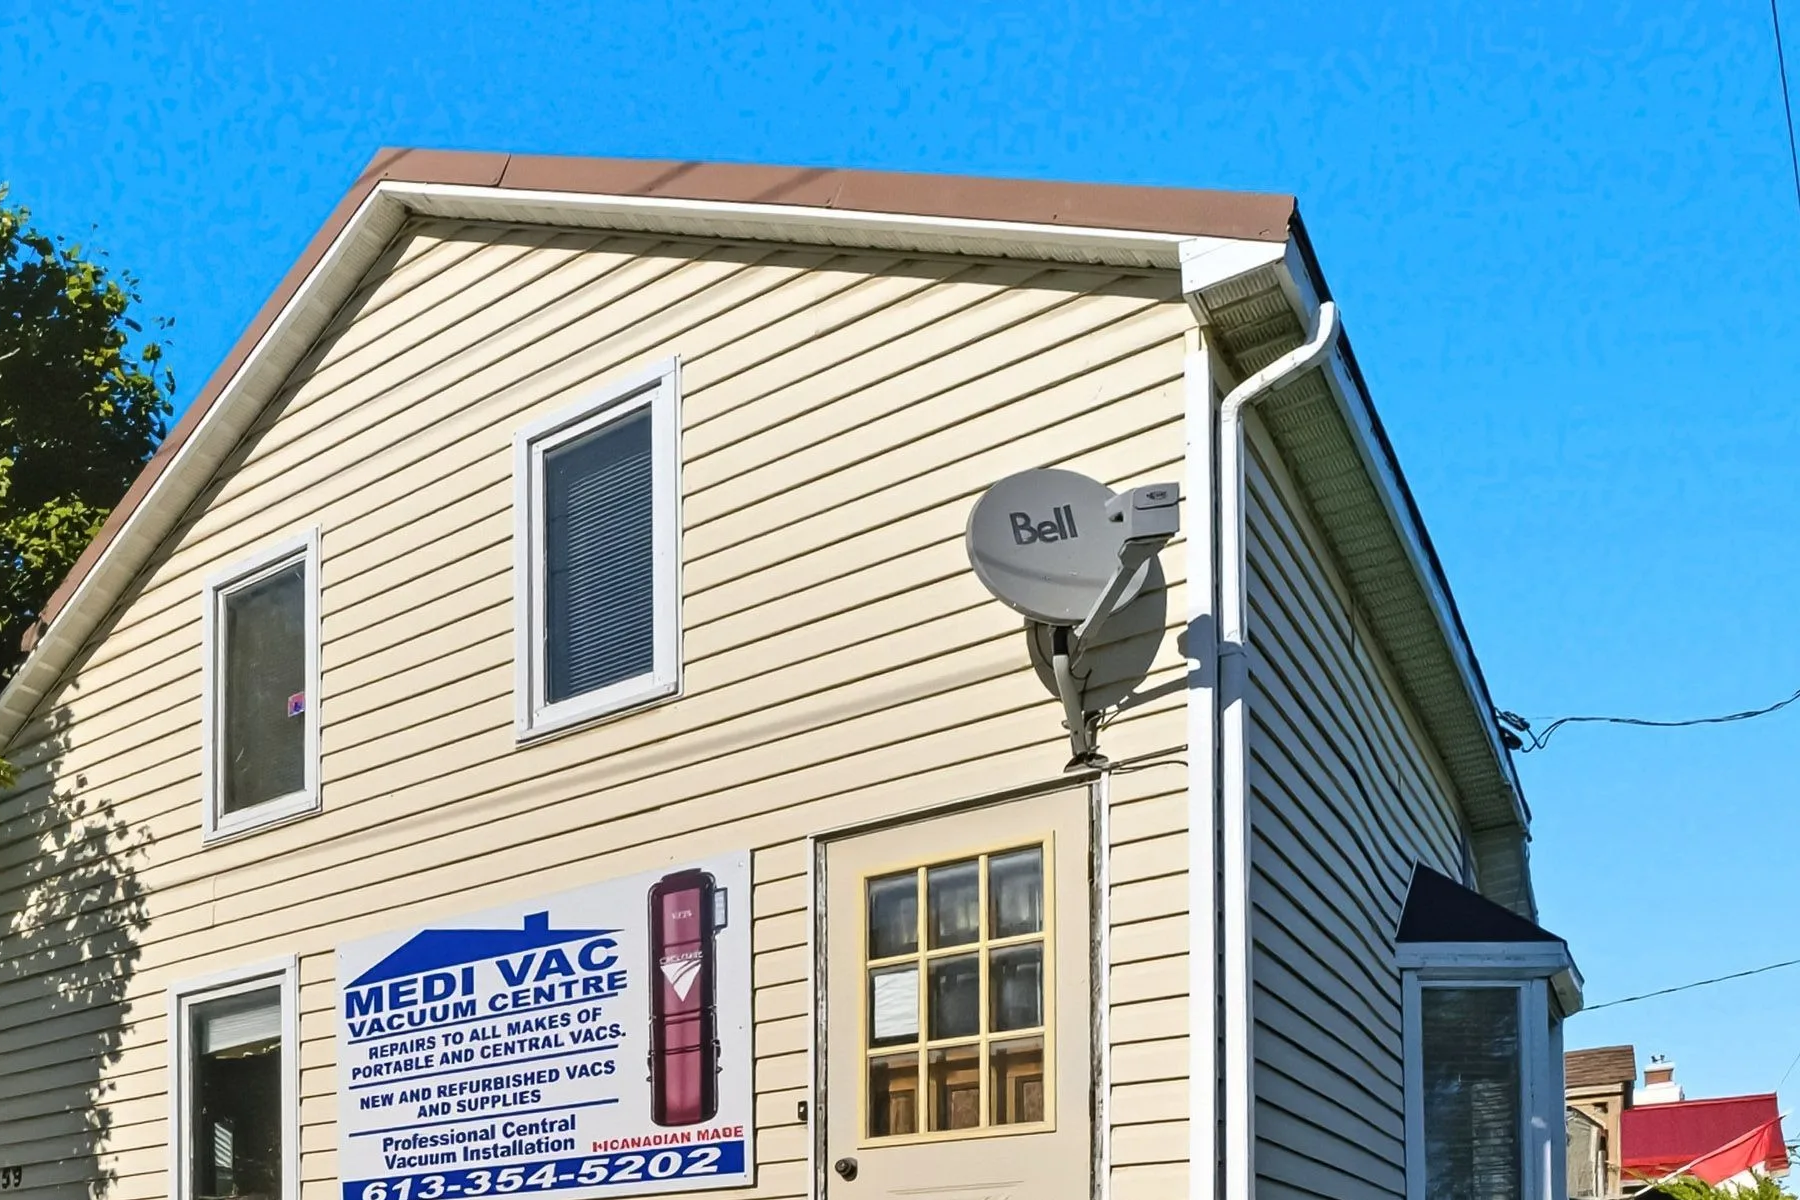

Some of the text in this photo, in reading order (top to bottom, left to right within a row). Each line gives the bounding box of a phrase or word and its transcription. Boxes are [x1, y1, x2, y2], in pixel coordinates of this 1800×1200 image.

[1009, 504, 1078, 545] Bell
[345, 938, 619, 1019] MEDI VAC
[348, 969, 628, 1038] VACUUM CENTRE
[352, 1023, 626, 1080] PORTABLE AND CENTRAL VACS.
[369, 1007, 602, 1060] REPAIRS TO ALL MAKES OF
[360, 1059, 616, 1110] NEW AND REFURBISHED VACS
[417, 1089, 541, 1118] AND SUPPLIES
[382, 1114, 576, 1152] Professional Central
[384, 1137, 575, 1170] Vacuum Installation
[610, 1125, 744, 1151] CANADIAN MADE
